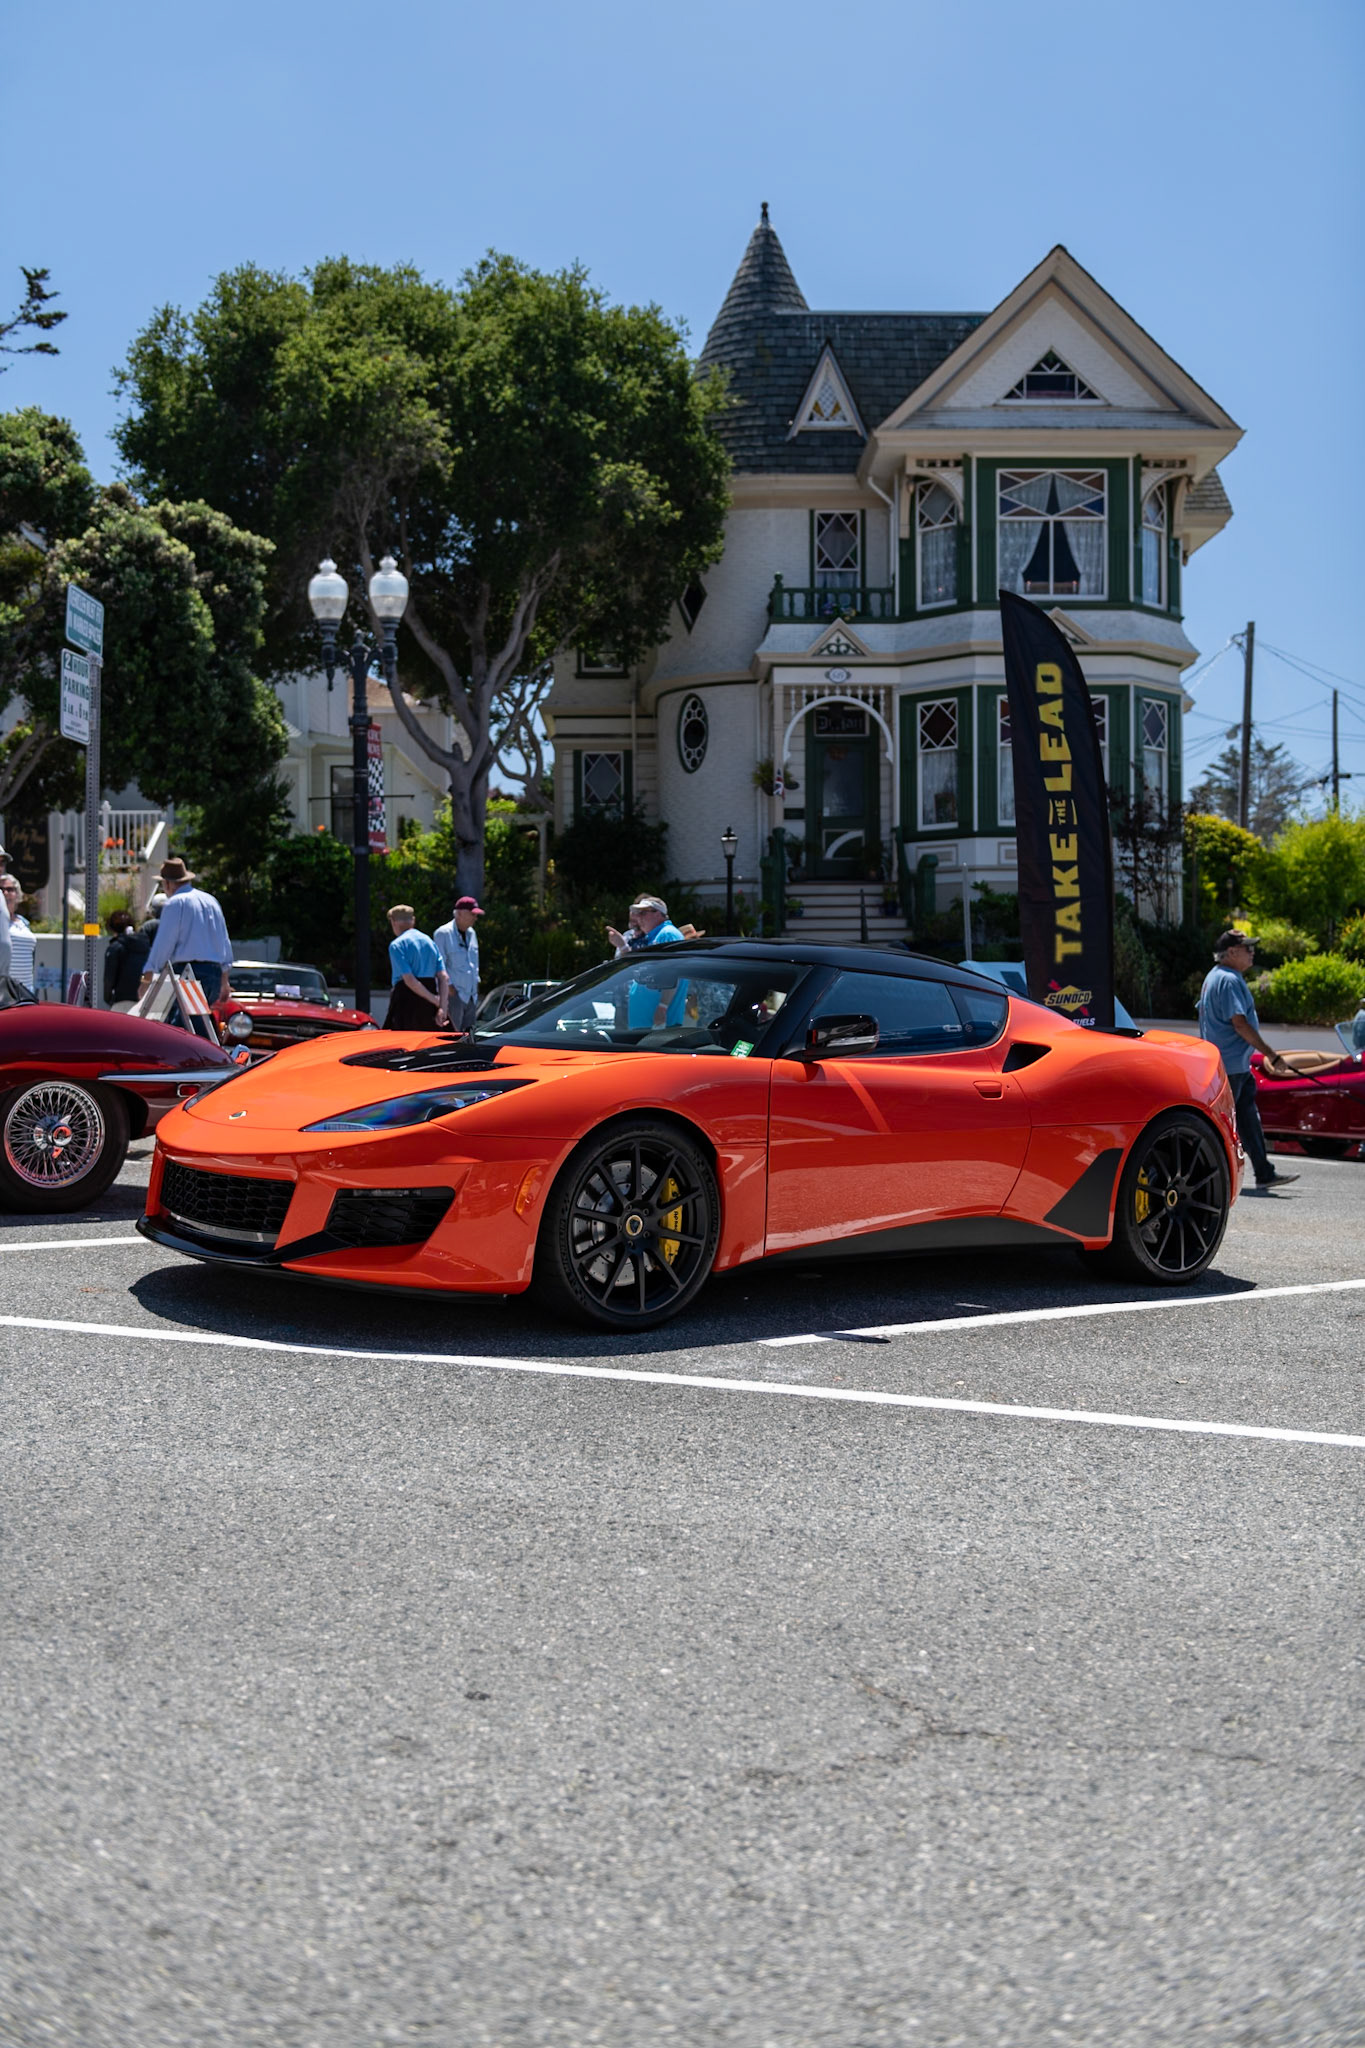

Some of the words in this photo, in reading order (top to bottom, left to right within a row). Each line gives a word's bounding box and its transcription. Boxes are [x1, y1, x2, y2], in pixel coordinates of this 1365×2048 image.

[65, 653, 72, 670] 2
[63, 676, 90, 700] PARKING
[1036, 663, 1072, 791] LEAD
[1055, 799, 1067, 825] THE
[1049, 833, 1082, 964] TAKE
[1046, 992, 1090, 1005] SUNOCO
[559, 1219, 570, 1272] MICHELIN
